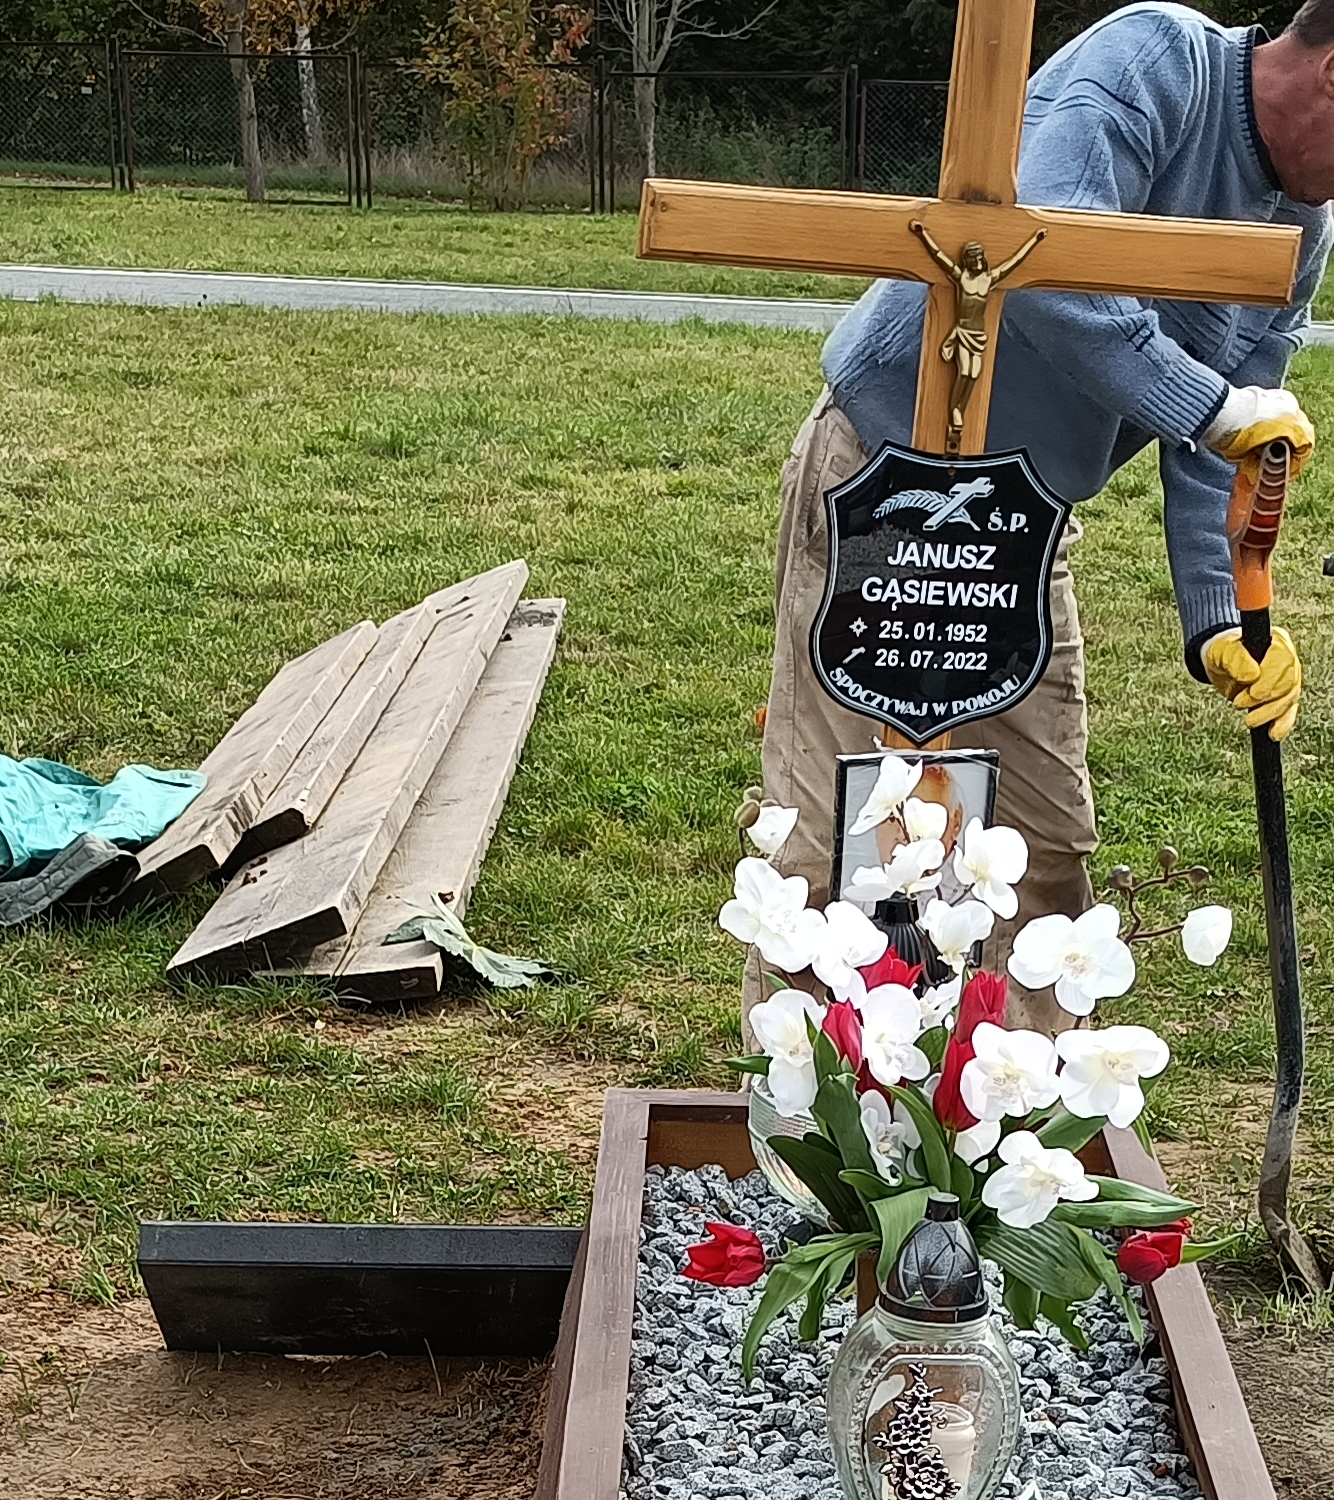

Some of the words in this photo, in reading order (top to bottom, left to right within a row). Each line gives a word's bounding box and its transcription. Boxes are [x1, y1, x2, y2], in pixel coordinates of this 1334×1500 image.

[886, 540, 997, 571] JANUSZ
[860, 575, 1019, 612] GĄSIEWSKI
[877, 619, 989, 643] 25.01.1952
[874, 648, 989, 671] 26.07.2022
[829, 666, 928, 717] SPOCZYWAJ
[931, 702, 949, 717] W
[951, 674, 1022, 715] POKOJU
